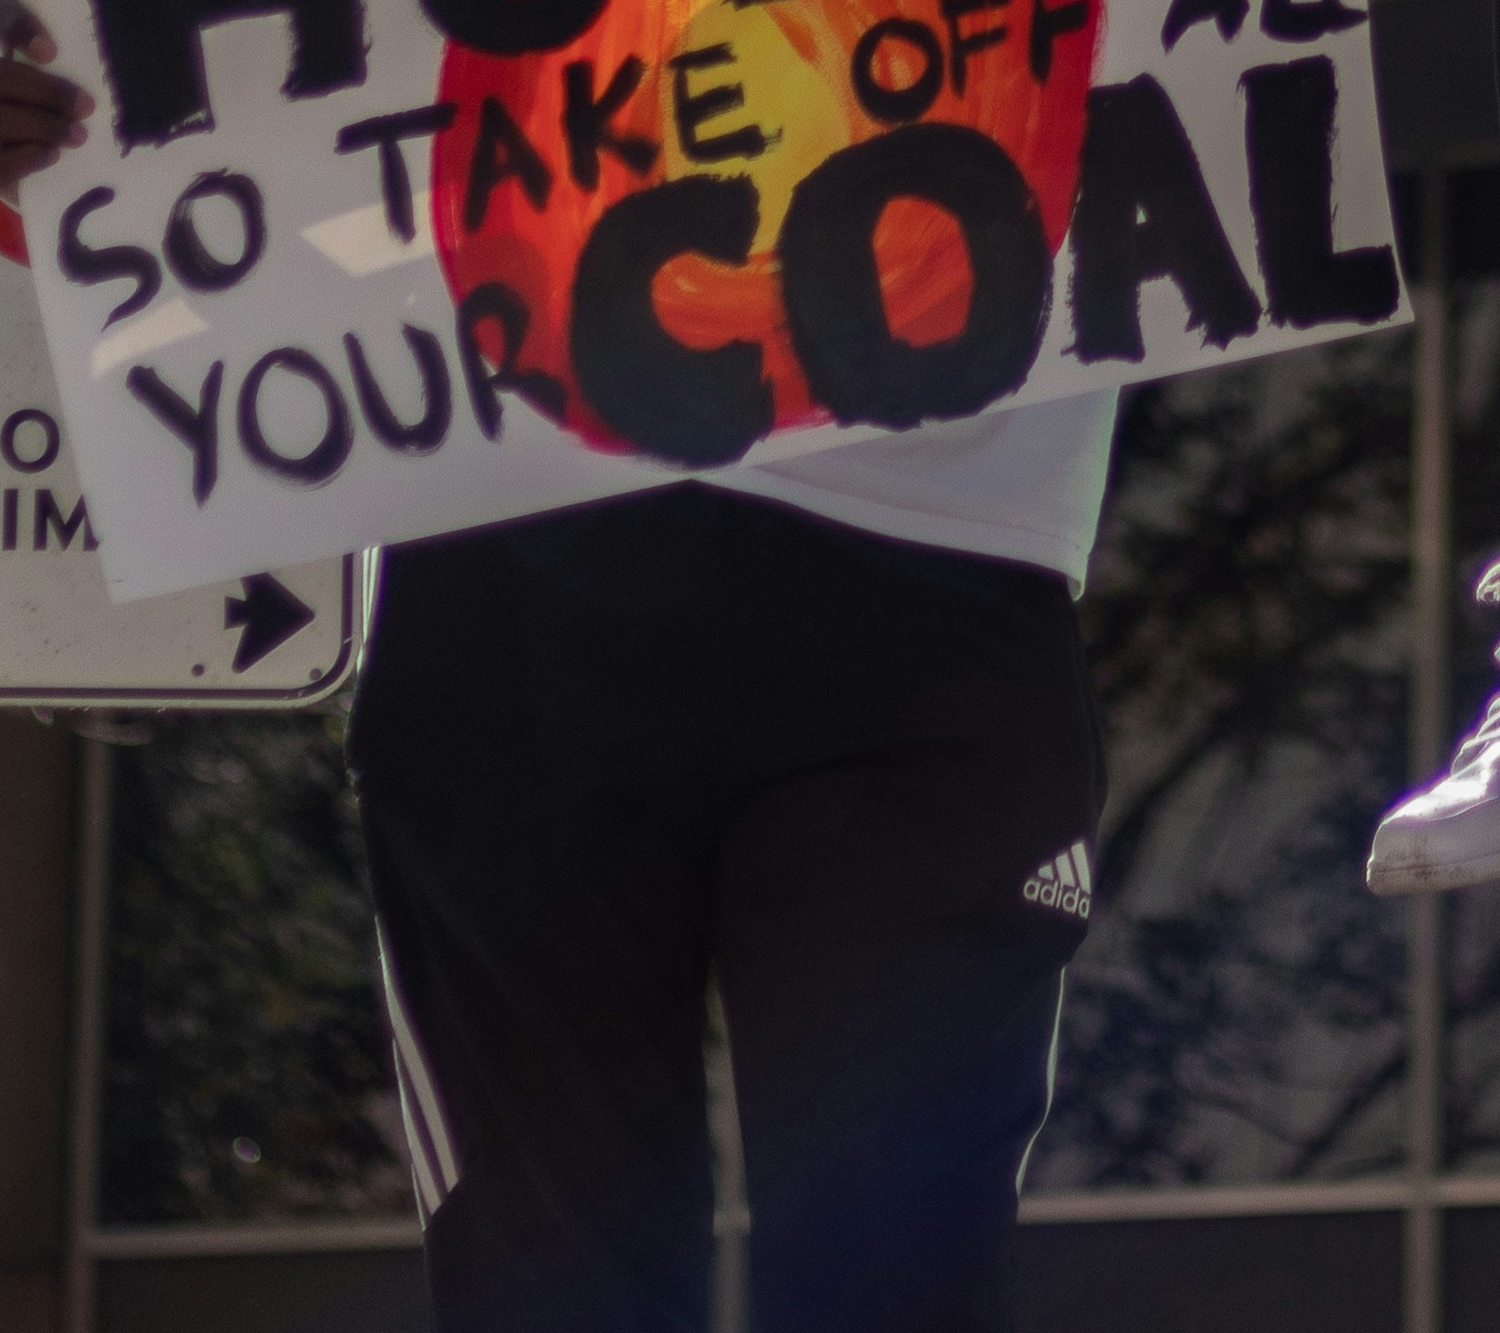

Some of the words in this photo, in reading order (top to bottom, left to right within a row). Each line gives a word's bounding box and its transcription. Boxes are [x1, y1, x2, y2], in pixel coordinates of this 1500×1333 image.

[57, 167, 267, 332] SO
[335, 41, 783, 244] TAKE
[126, 281, 570, 510] YOUR
[568, 53, 1402, 471] COAL
[1023, 878, 1091, 919] adida
